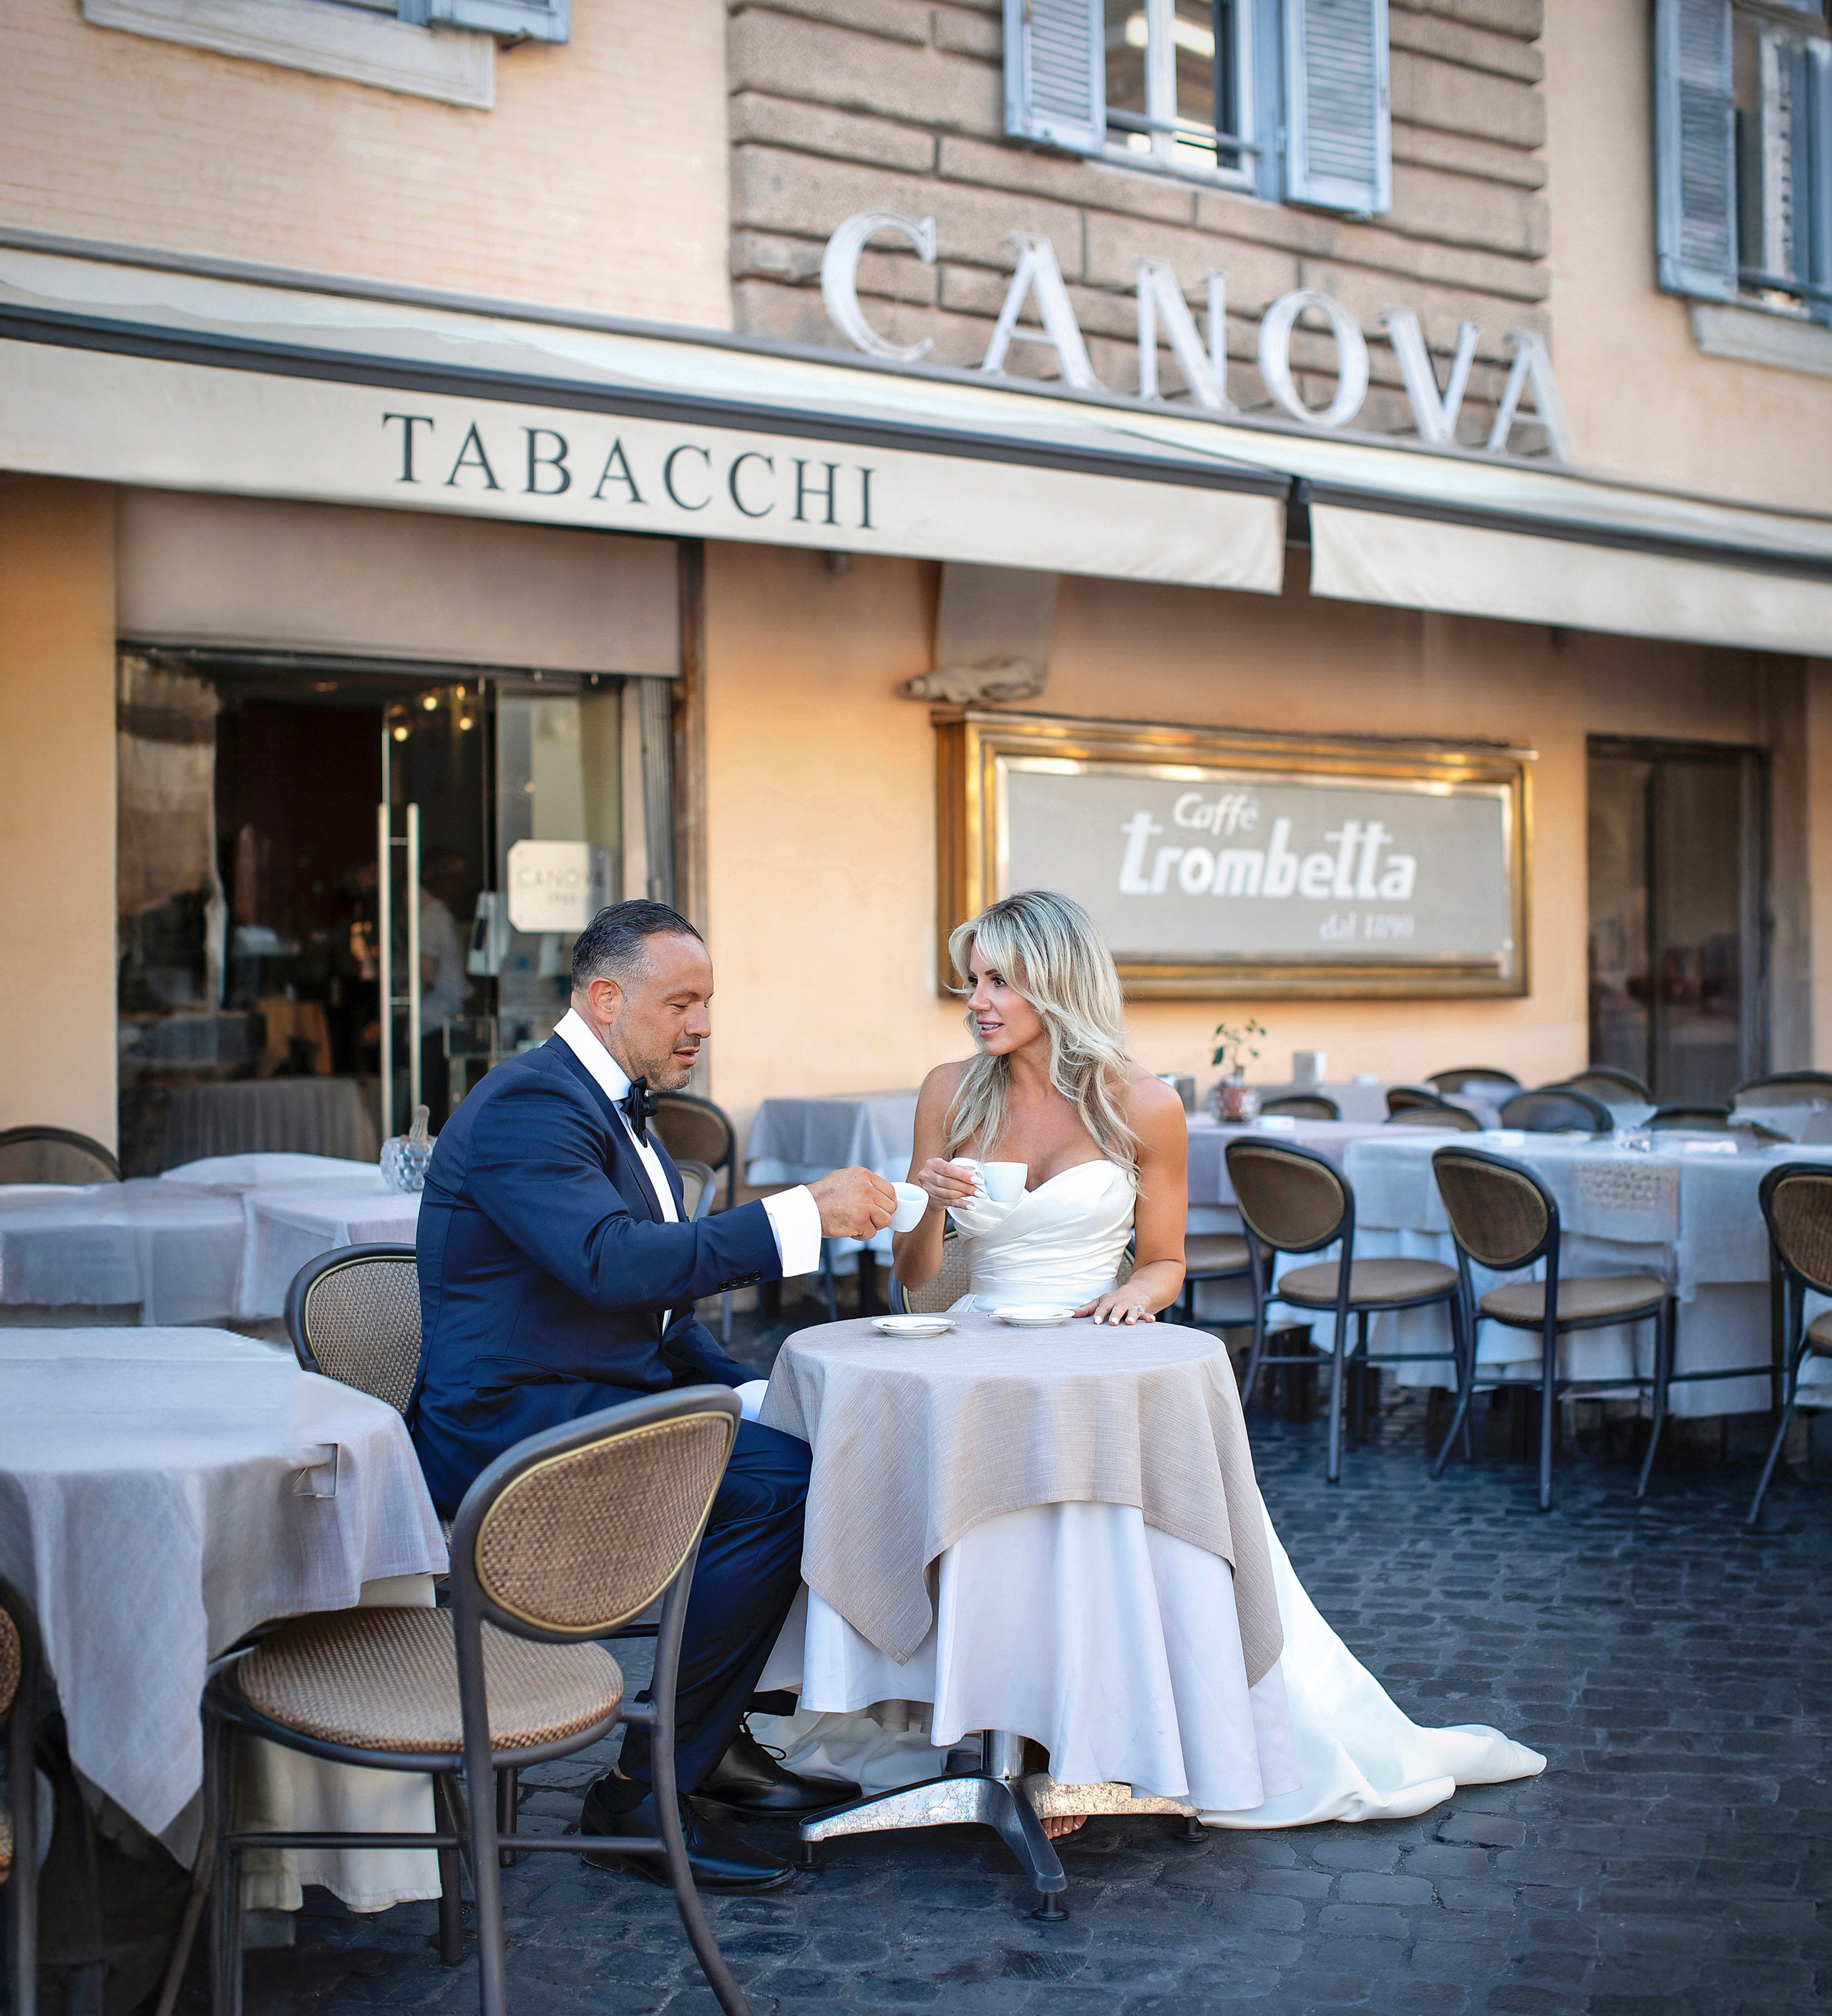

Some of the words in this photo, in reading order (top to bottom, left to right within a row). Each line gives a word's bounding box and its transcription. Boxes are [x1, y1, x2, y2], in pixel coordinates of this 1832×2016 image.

[822, 208, 1572, 464] CANOVA
[382, 412, 877, 529] TABACCHI
[1119, 810, 1418, 902] trombetta
[1320, 911, 1358, 942] dal
